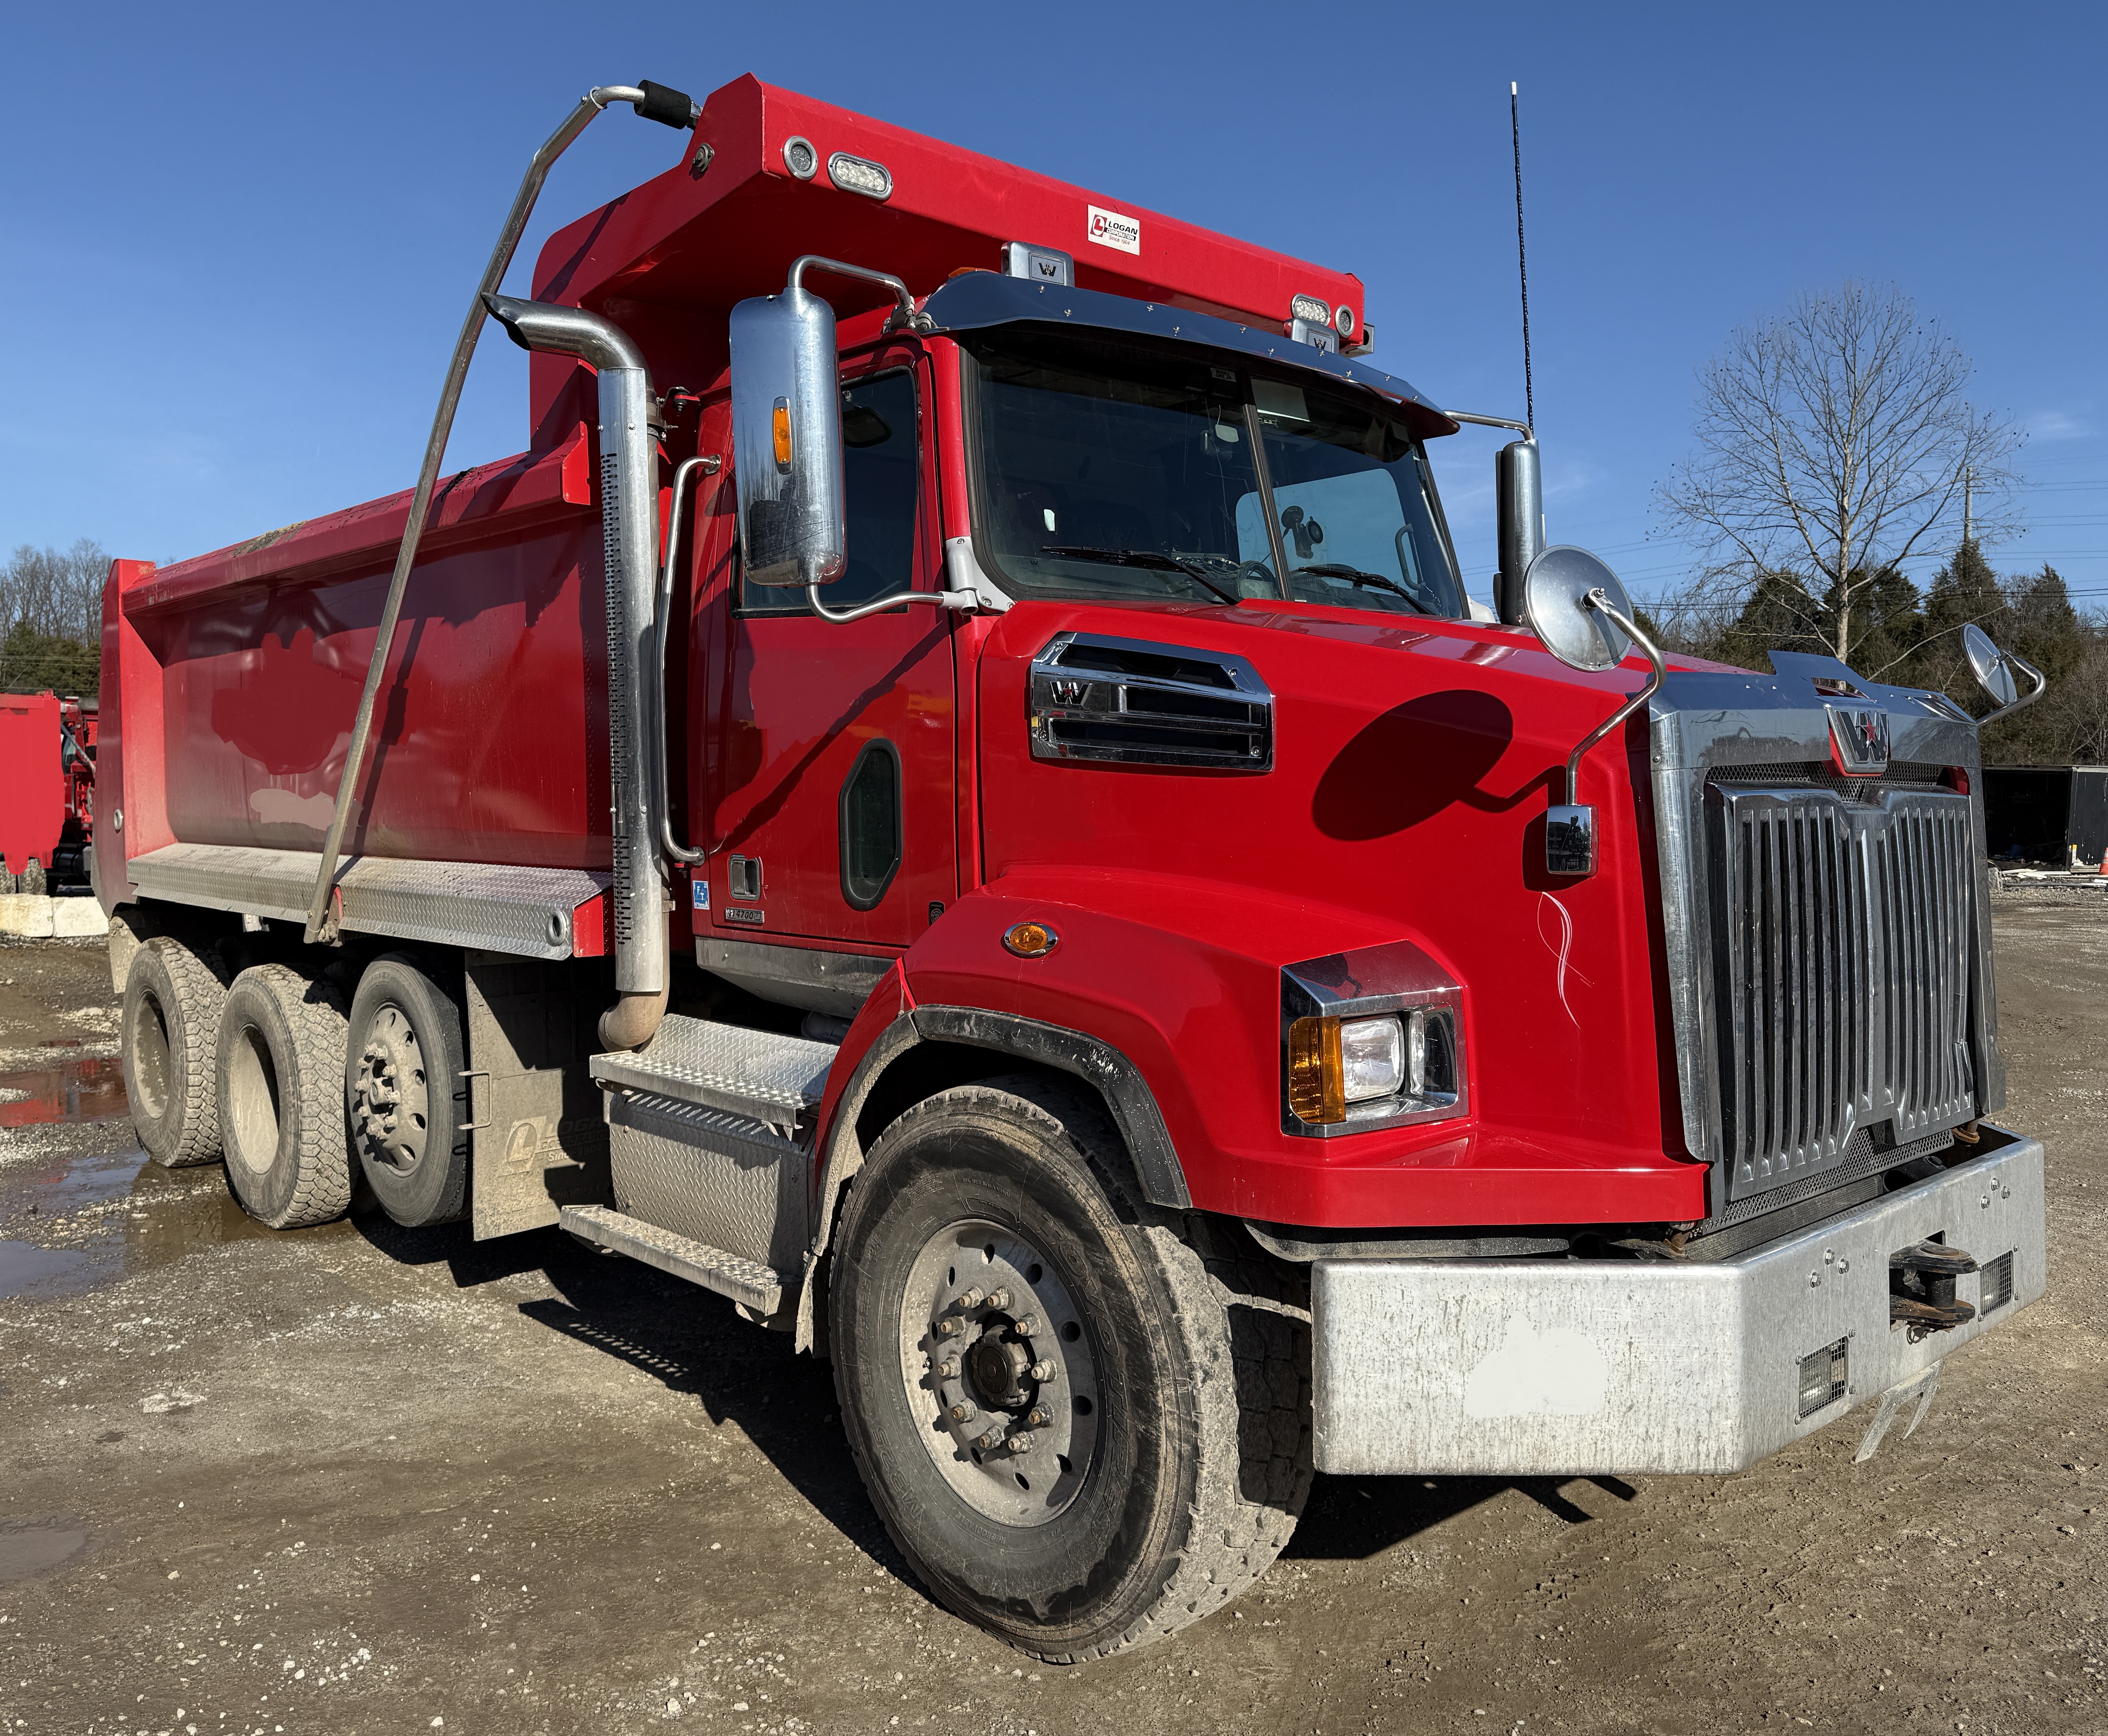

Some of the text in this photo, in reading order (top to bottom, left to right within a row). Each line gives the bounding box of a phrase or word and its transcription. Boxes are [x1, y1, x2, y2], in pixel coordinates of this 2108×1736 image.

[1106, 228, 1135, 241] CORPORATION
[1108, 221, 1138, 235] LOGAN
[542, 1115, 609, 1138] LOGA
[548, 1150, 576, 1162] Since
[1084, 1369, 1131, 1550] TIRES
[869, 1423, 926, 1524] M325
